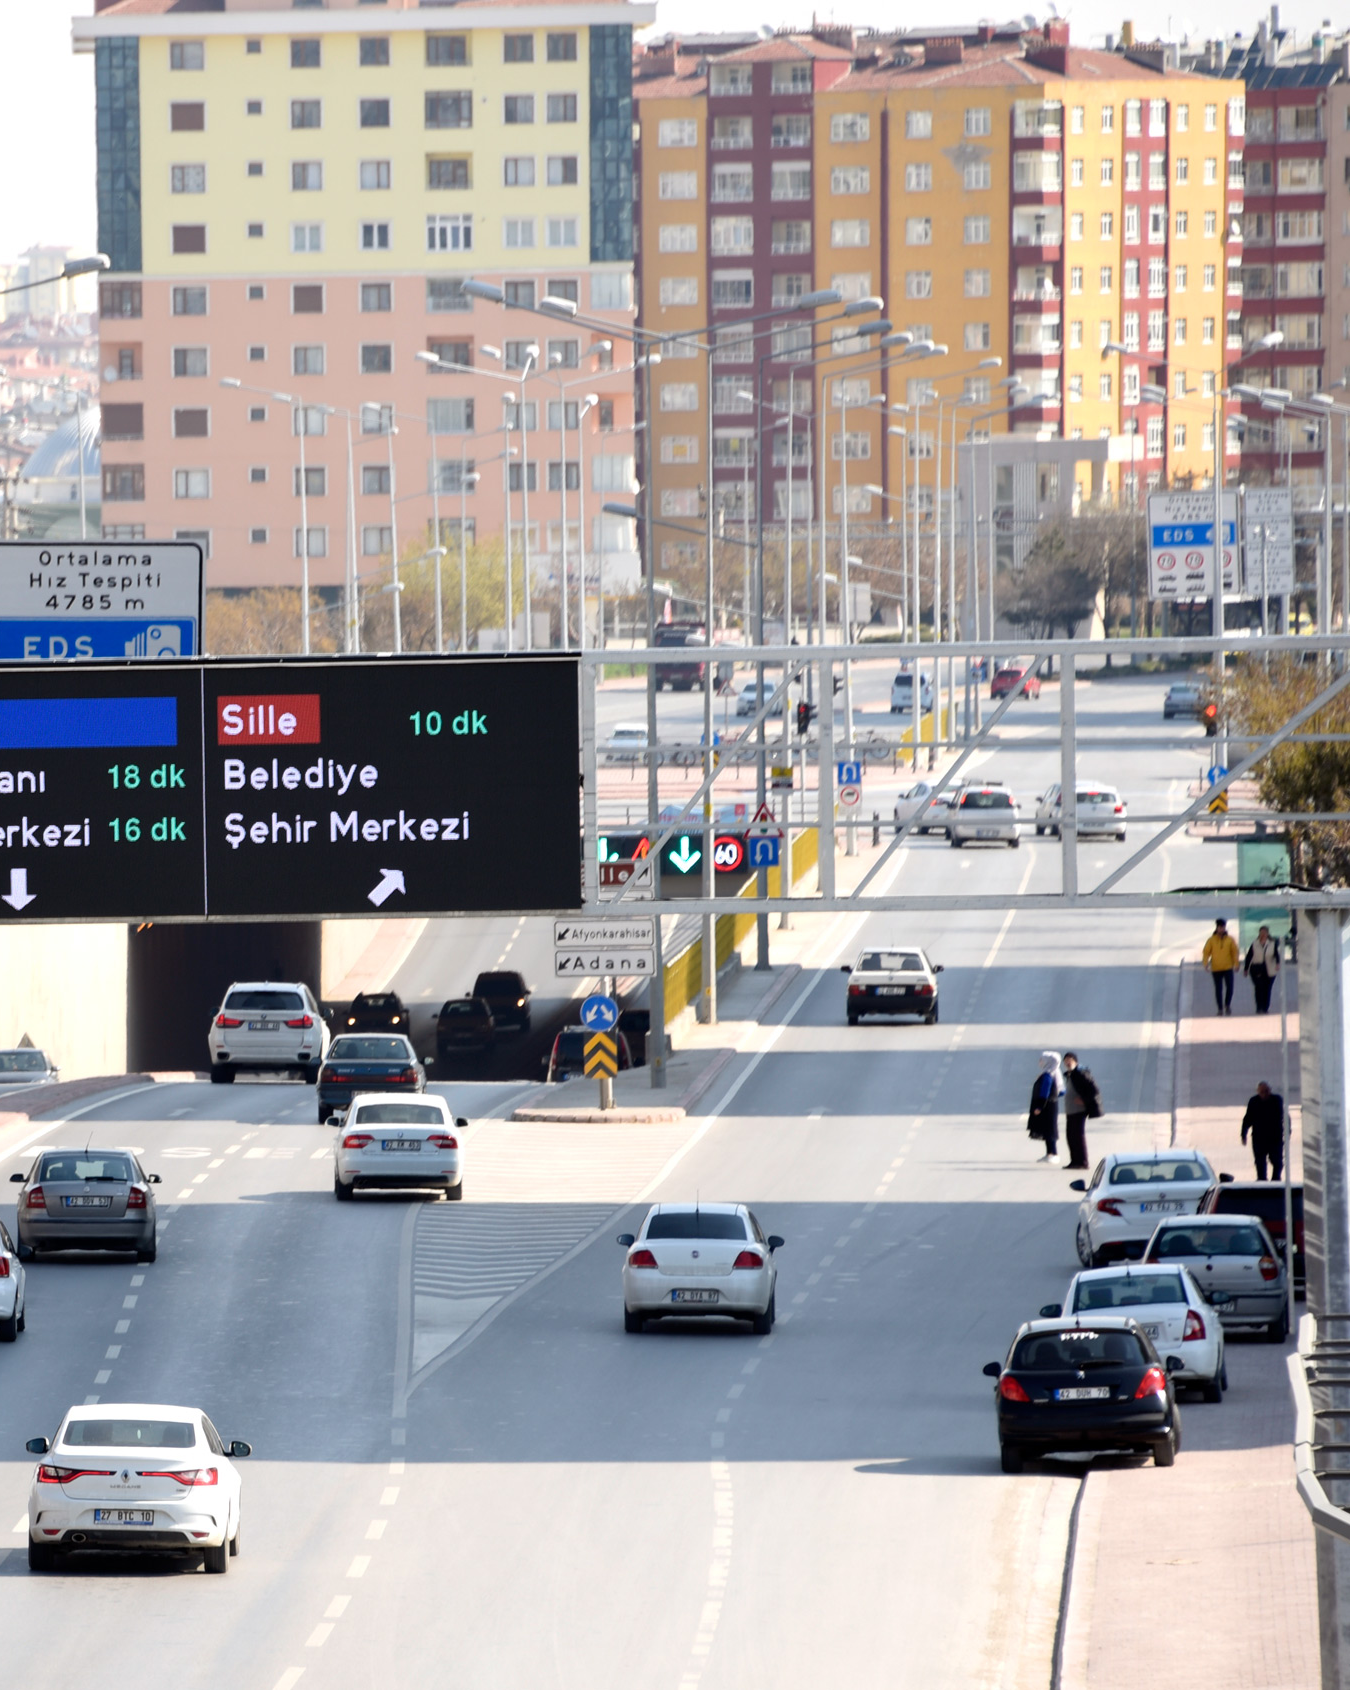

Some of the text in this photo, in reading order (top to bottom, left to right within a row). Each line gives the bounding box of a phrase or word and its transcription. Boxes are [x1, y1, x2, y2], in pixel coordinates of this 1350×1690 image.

[1163, 529, 1194, 543] EDS
[39, 551, 152, 567] Ortalama
[30, 573, 162, 591] Hız Tespiti
[46, 595, 145, 611] 4785 m
[24, 637, 94, 659] EDS
[222, 703, 488, 736] Sille 10 dk
[107, 766, 140, 789] 18
[151, 763, 185, 788] dk
[224, 758, 378, 795] Belediye
[108, 818, 140, 842] 16
[151, 816, 186, 842] dk
[224, 811, 470, 849] Şehir Merkezi
[715, 844, 738, 865] 60
[572, 928, 651, 942] Afyonkarahisar
[573, 955, 646, 971] Adana
[677, 1291, 686, 1300] 42
[1060, 1389, 1071, 1398] 42
[100, 1510, 151, 1522] 27 BTC 10
